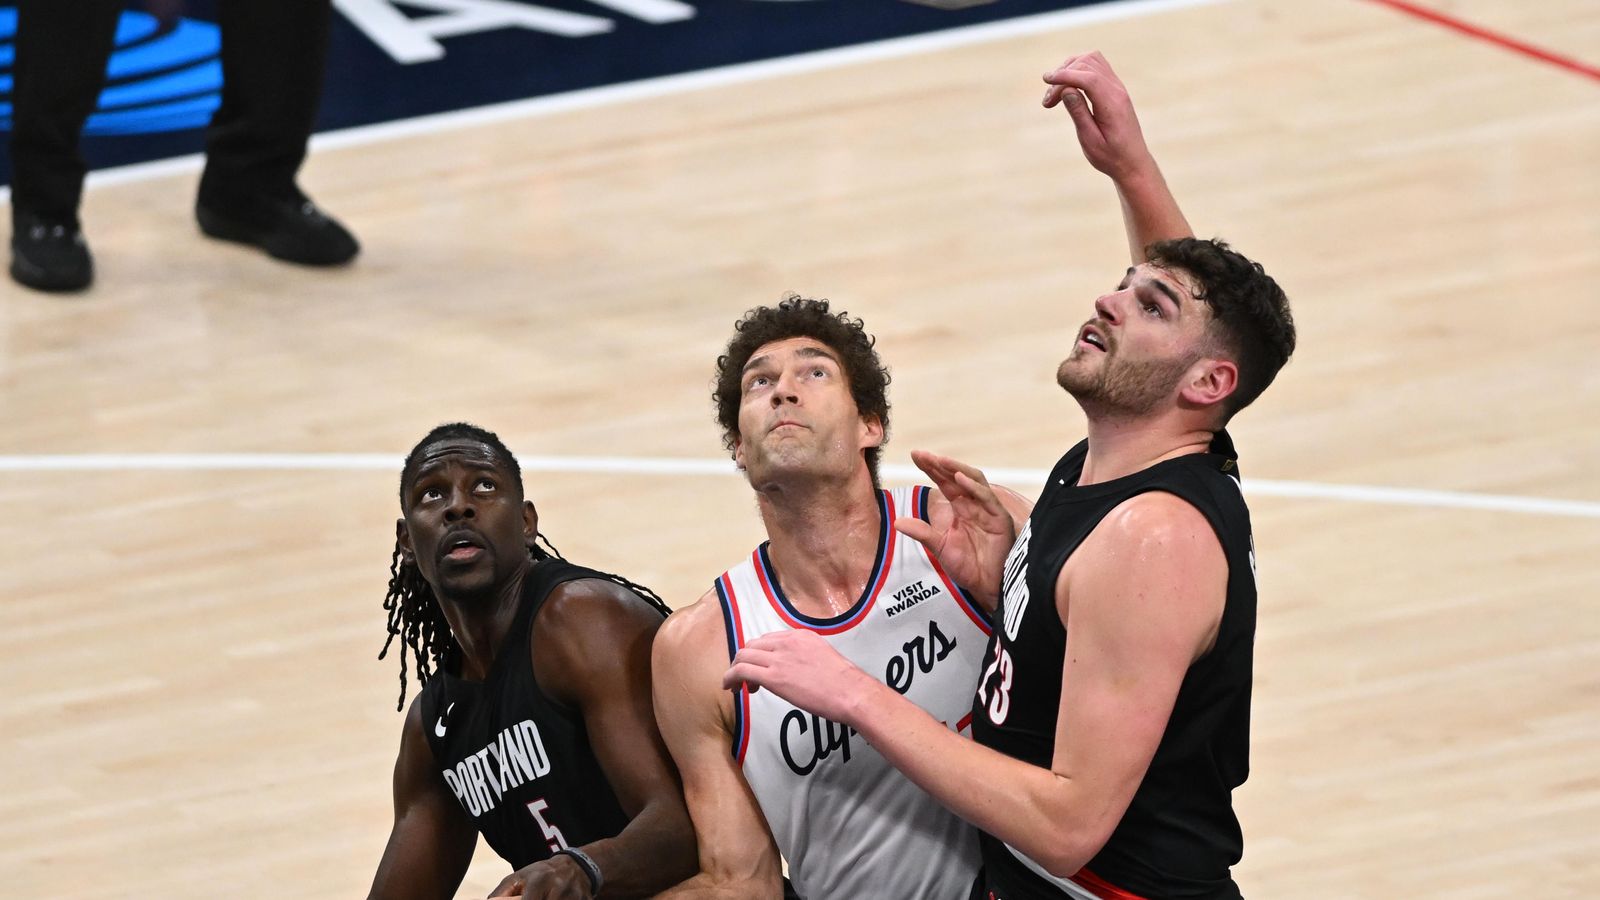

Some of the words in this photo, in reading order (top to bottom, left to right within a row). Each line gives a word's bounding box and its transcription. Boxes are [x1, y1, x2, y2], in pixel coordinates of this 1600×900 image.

[886, 585, 941, 617] RWANDA
[893, 581, 923, 601] VISIT
[526, 798, 569, 853] 5
